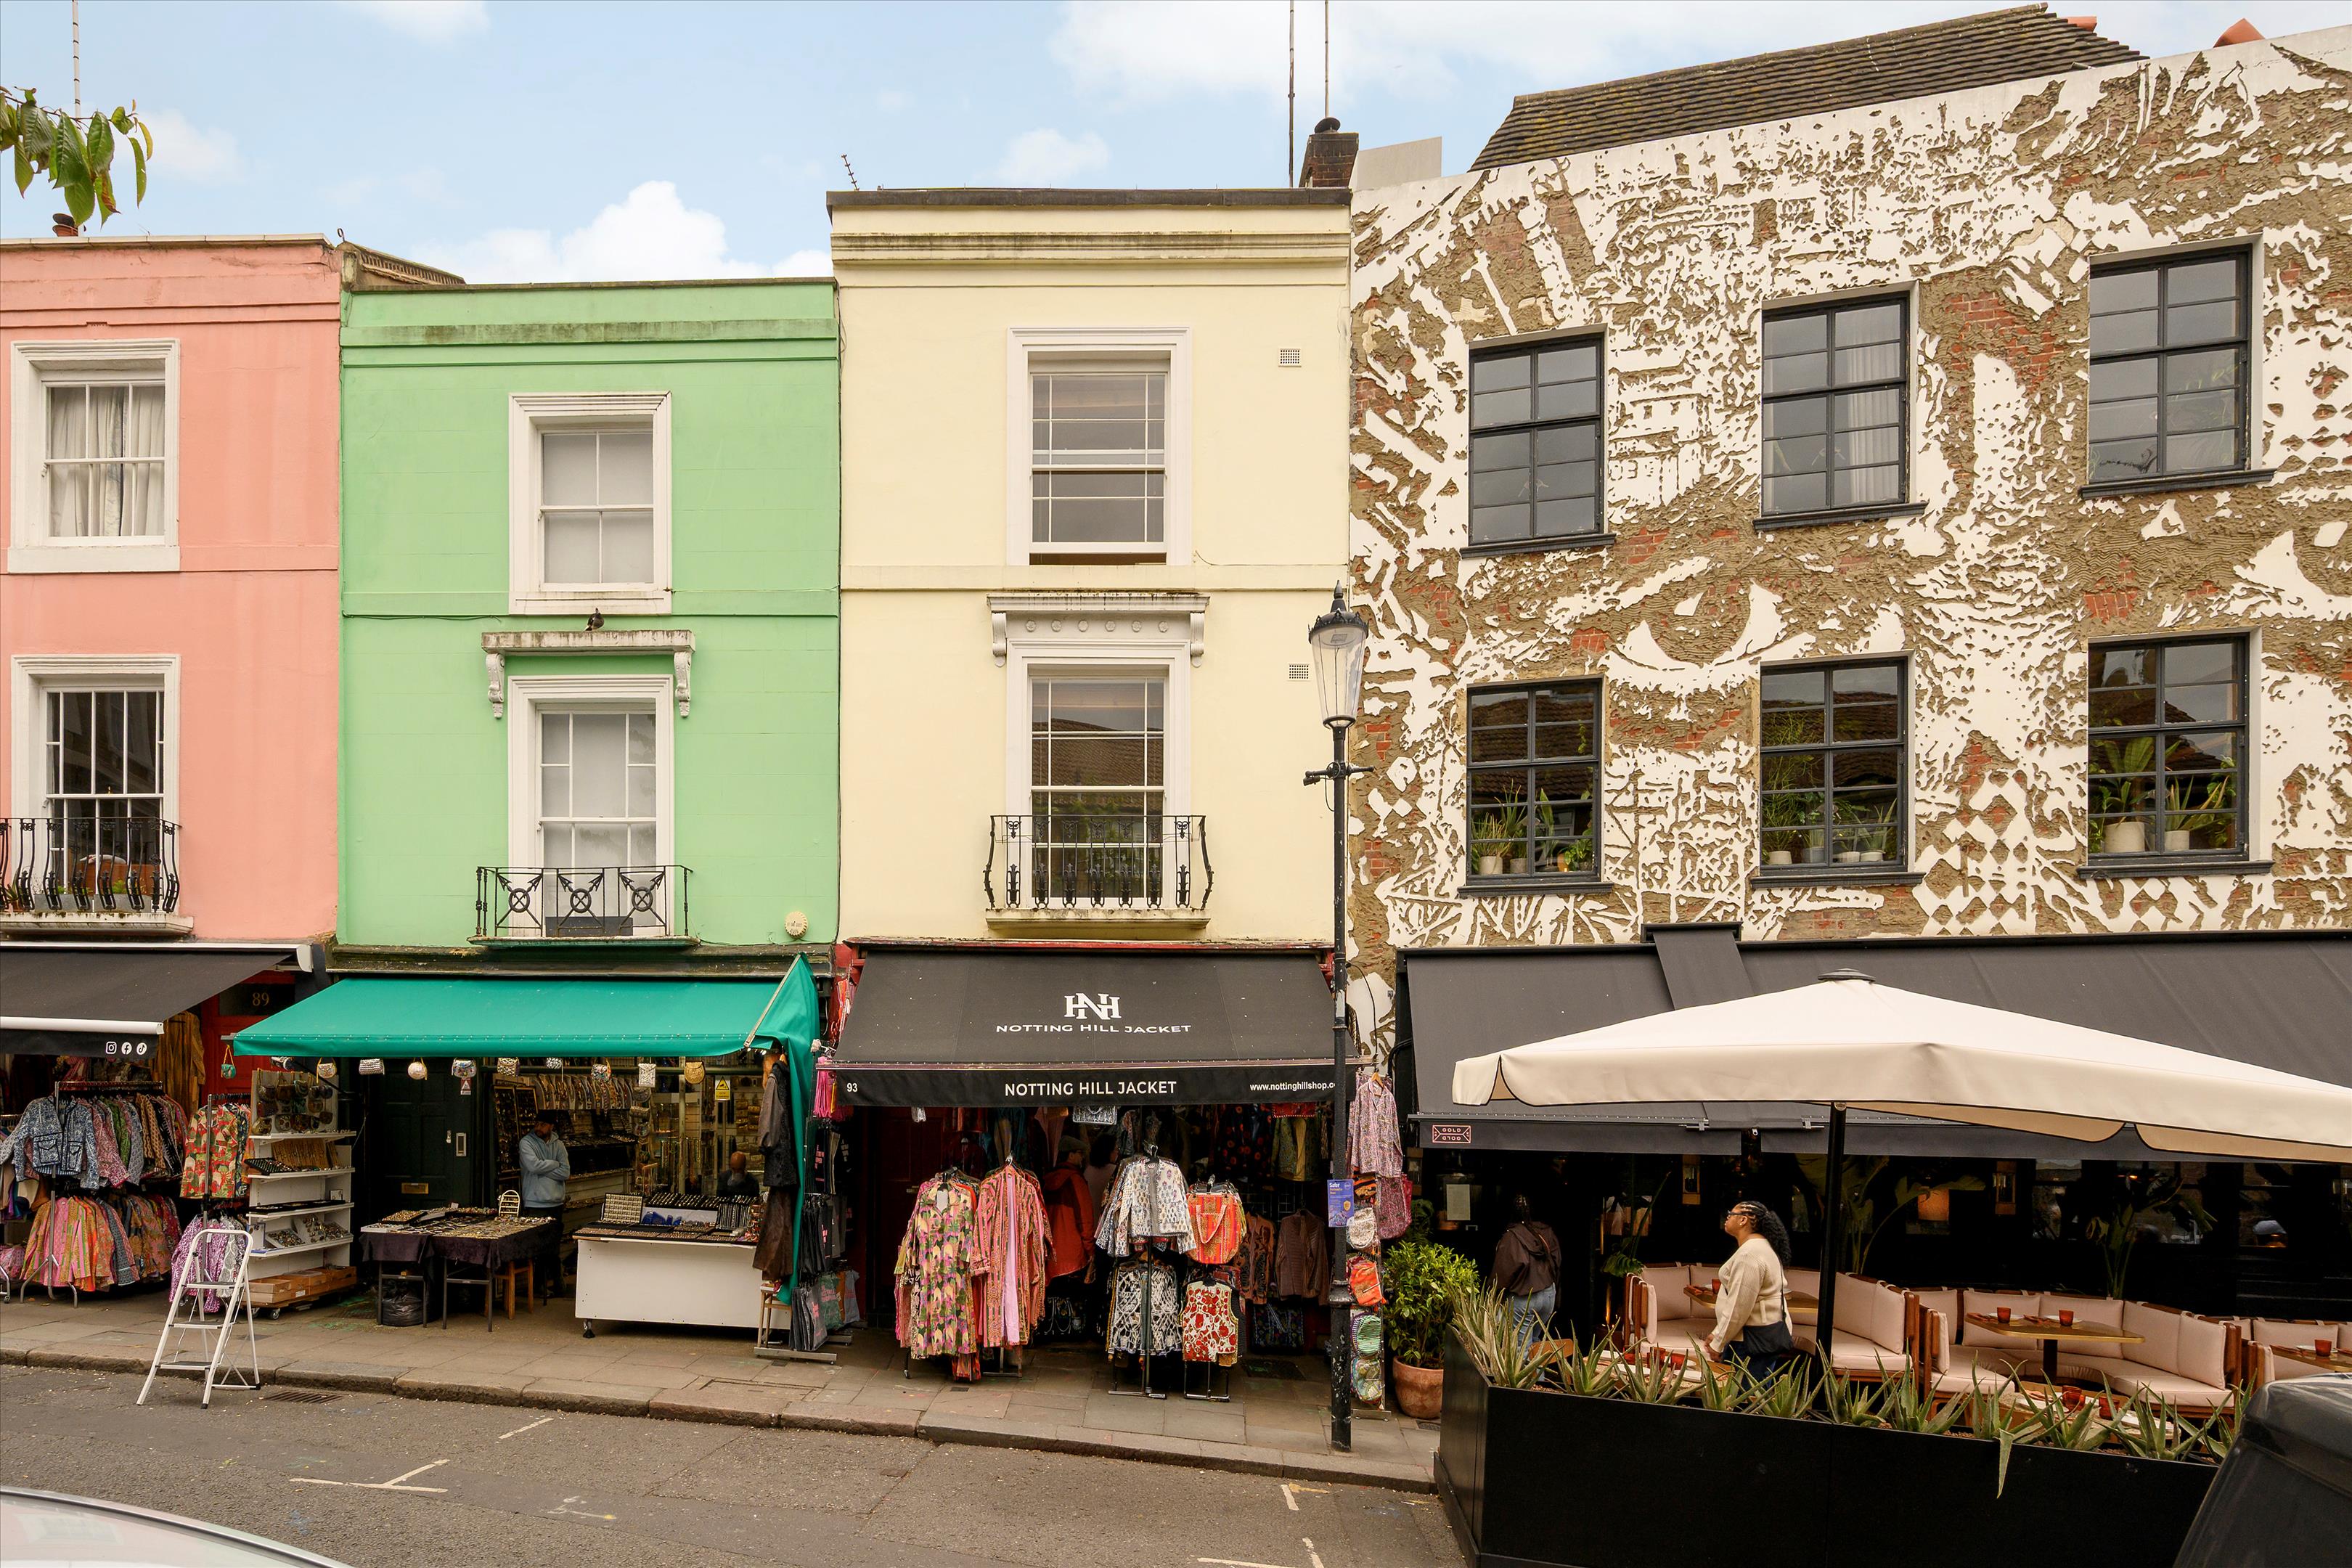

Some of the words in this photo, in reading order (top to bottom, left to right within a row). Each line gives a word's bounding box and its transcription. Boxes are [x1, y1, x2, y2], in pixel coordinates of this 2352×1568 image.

[252, 992, 270, 1006] 89
[846, 1082, 858, 1093] 93
[1005, 1082, 1074, 1096] NOTTING
[1079, 1082, 1114, 1095] HILL
[1118, 1081, 1177, 1095] JACKET
